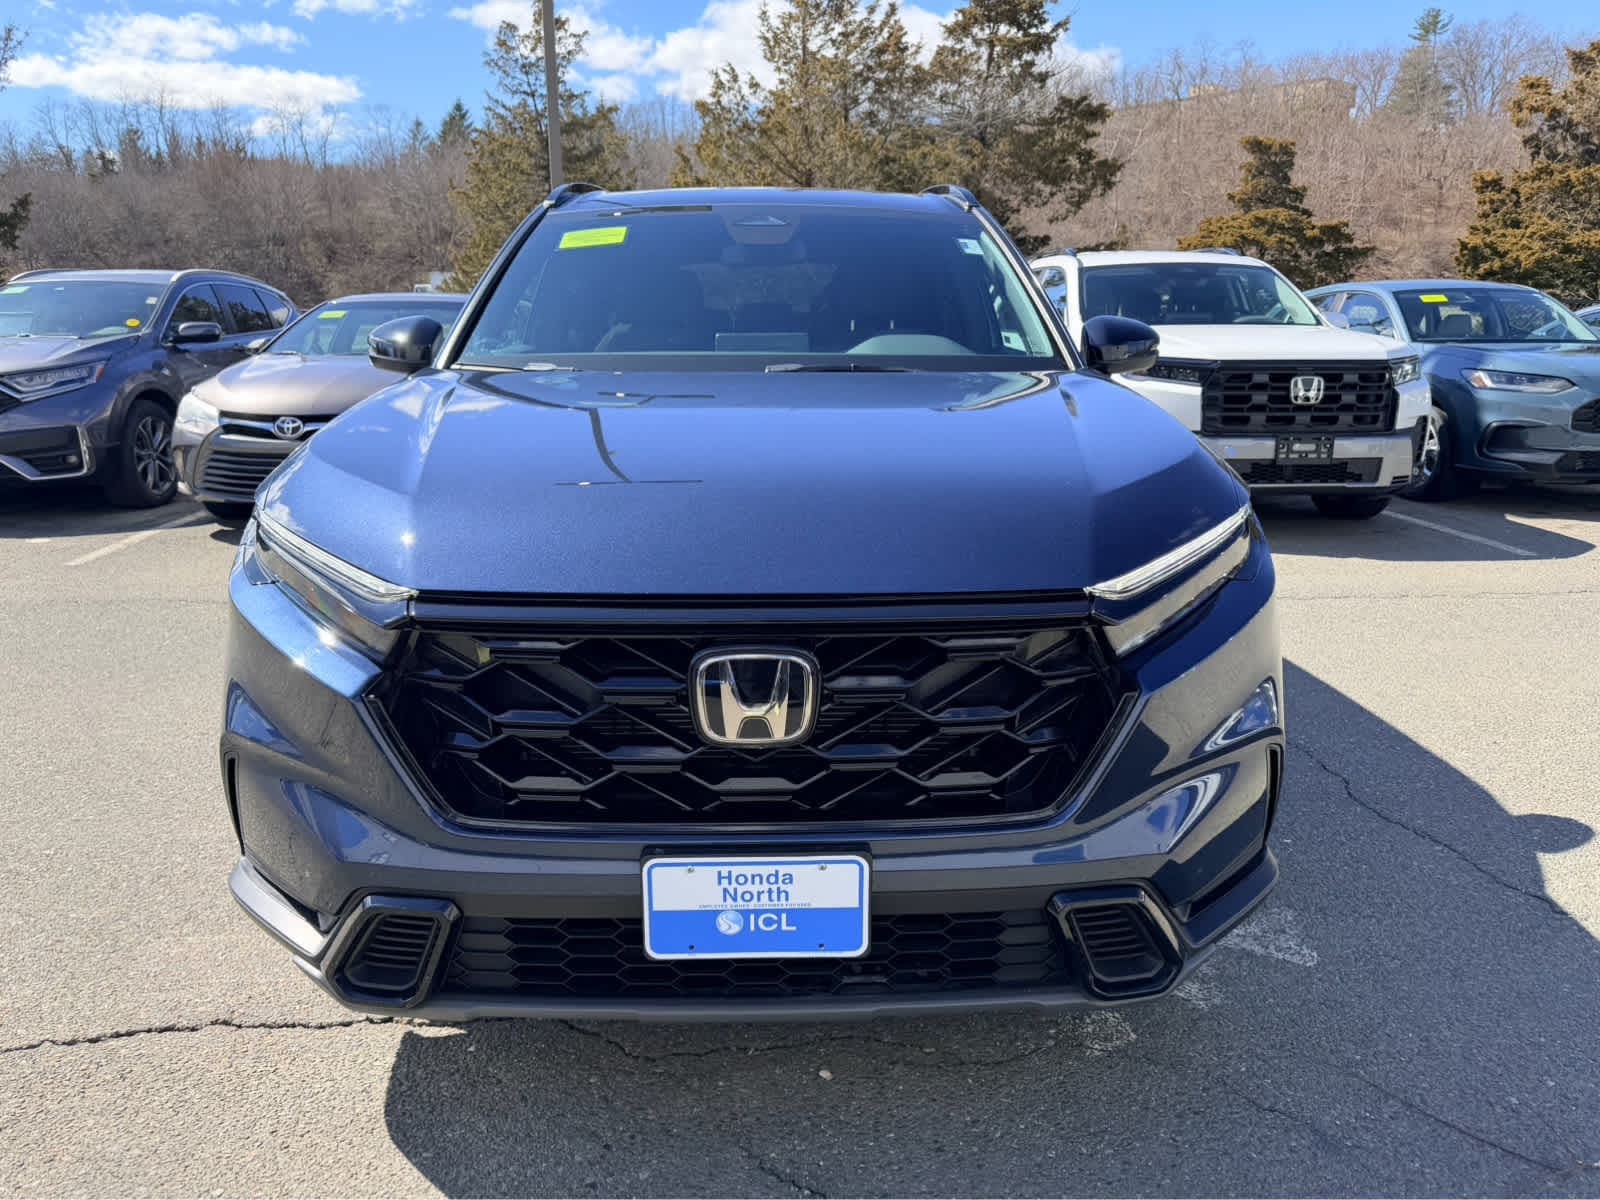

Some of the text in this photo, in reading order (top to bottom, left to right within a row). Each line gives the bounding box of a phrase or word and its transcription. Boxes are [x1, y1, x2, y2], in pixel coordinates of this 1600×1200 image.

[717, 869, 794, 886] Honda
[722, 886, 789, 903] North
[749, 912, 798, 932] ICL
